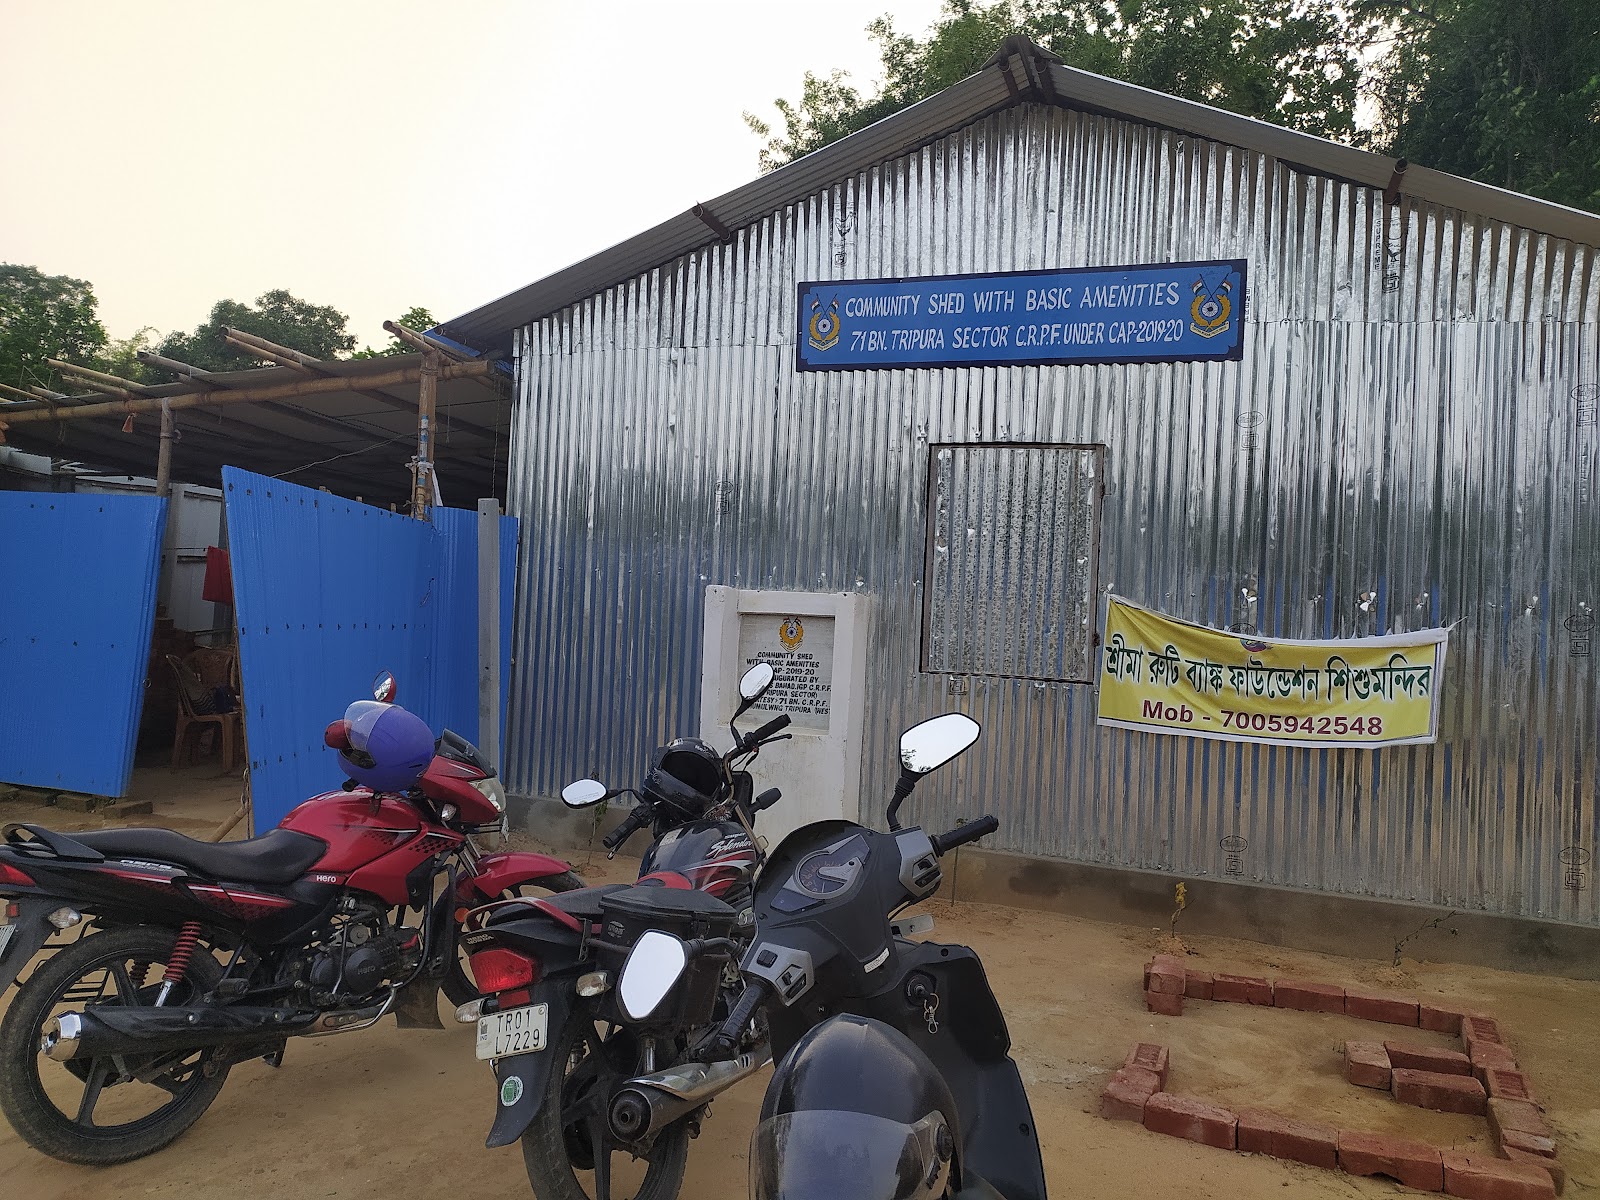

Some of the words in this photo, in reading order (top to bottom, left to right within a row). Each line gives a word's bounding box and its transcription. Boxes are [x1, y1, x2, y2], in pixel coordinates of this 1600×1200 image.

[846, 294, 920, 317] COMMUNITY
[928, 292, 965, 315] SHED
[973, 290, 1015, 313] WITH
[1025, 287, 1072, 312] BASIC
[1080, 282, 1180, 309] AMENITIES
[892, 328, 945, 351] TRIPURA
[952, 326, 1008, 348] SECTOR
[1015, 324, 1061, 347] C.R.P.F.
[1063, 322, 1104, 345] UNDER
[1105, 633, 1144, 683] শ্রীমা
[1148, 644, 1180, 687] রুটি
[1184, 658, 1223, 695] ব্যাঙ্ক
[1227, 656, 1320, 700] ফাউন্ডেশন
[1324, 654, 1432, 701] শিশুমন্দির
[1142, 700, 1194, 723] Mob
[1220, 710, 1382, 735] 7005942548
[497, 1009, 531, 1032] TR01
[495, 1028, 540, 1054] L7229
